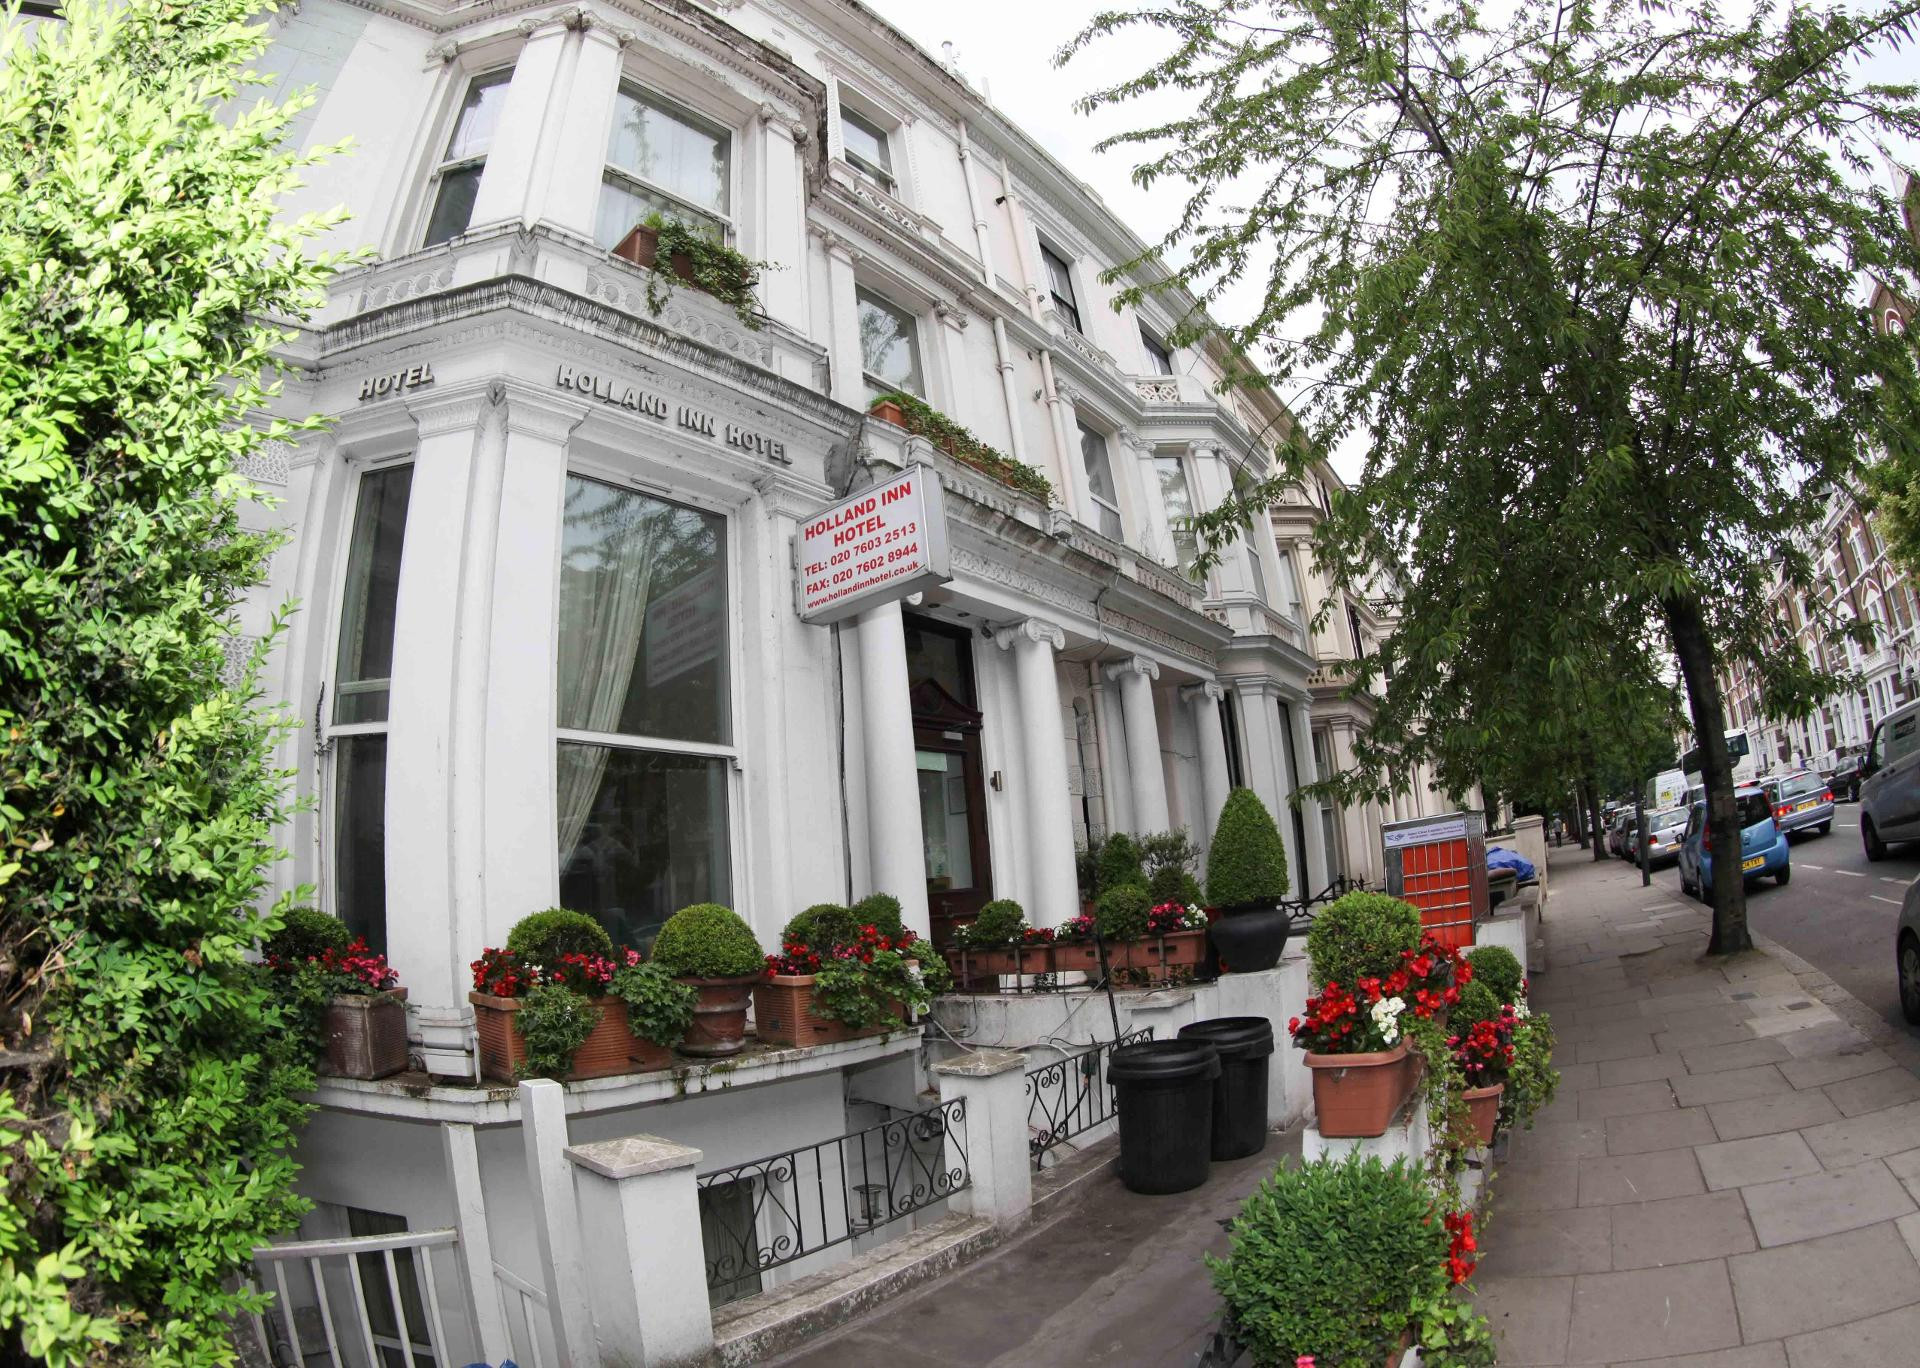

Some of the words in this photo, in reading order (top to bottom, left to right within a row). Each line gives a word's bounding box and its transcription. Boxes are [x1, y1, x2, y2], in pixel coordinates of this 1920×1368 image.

[358, 362, 434, 401] HOTEL
[557, 364, 668, 420] HOLLAND
[678, 406, 716, 437] INN
[727, 423, 793, 465] HOTEL
[805, 498, 876, 541] HOLLAND
[881, 481, 911, 506] INN
[834, 515, 886, 547] HOTEL
[805, 561, 828, 577] TEL:
[830, 550, 851, 566] 020
[853, 537, 882, 556] 7603
[884, 522, 917, 544] 2513
[806, 578, 830, 595] FAX:
[832, 568, 853, 584] 020
[856, 556, 884, 575] 7602
[887, 542, 918, 563] 8944
[807, 560, 919, 609] www.hollandinnhotel.co.uk
